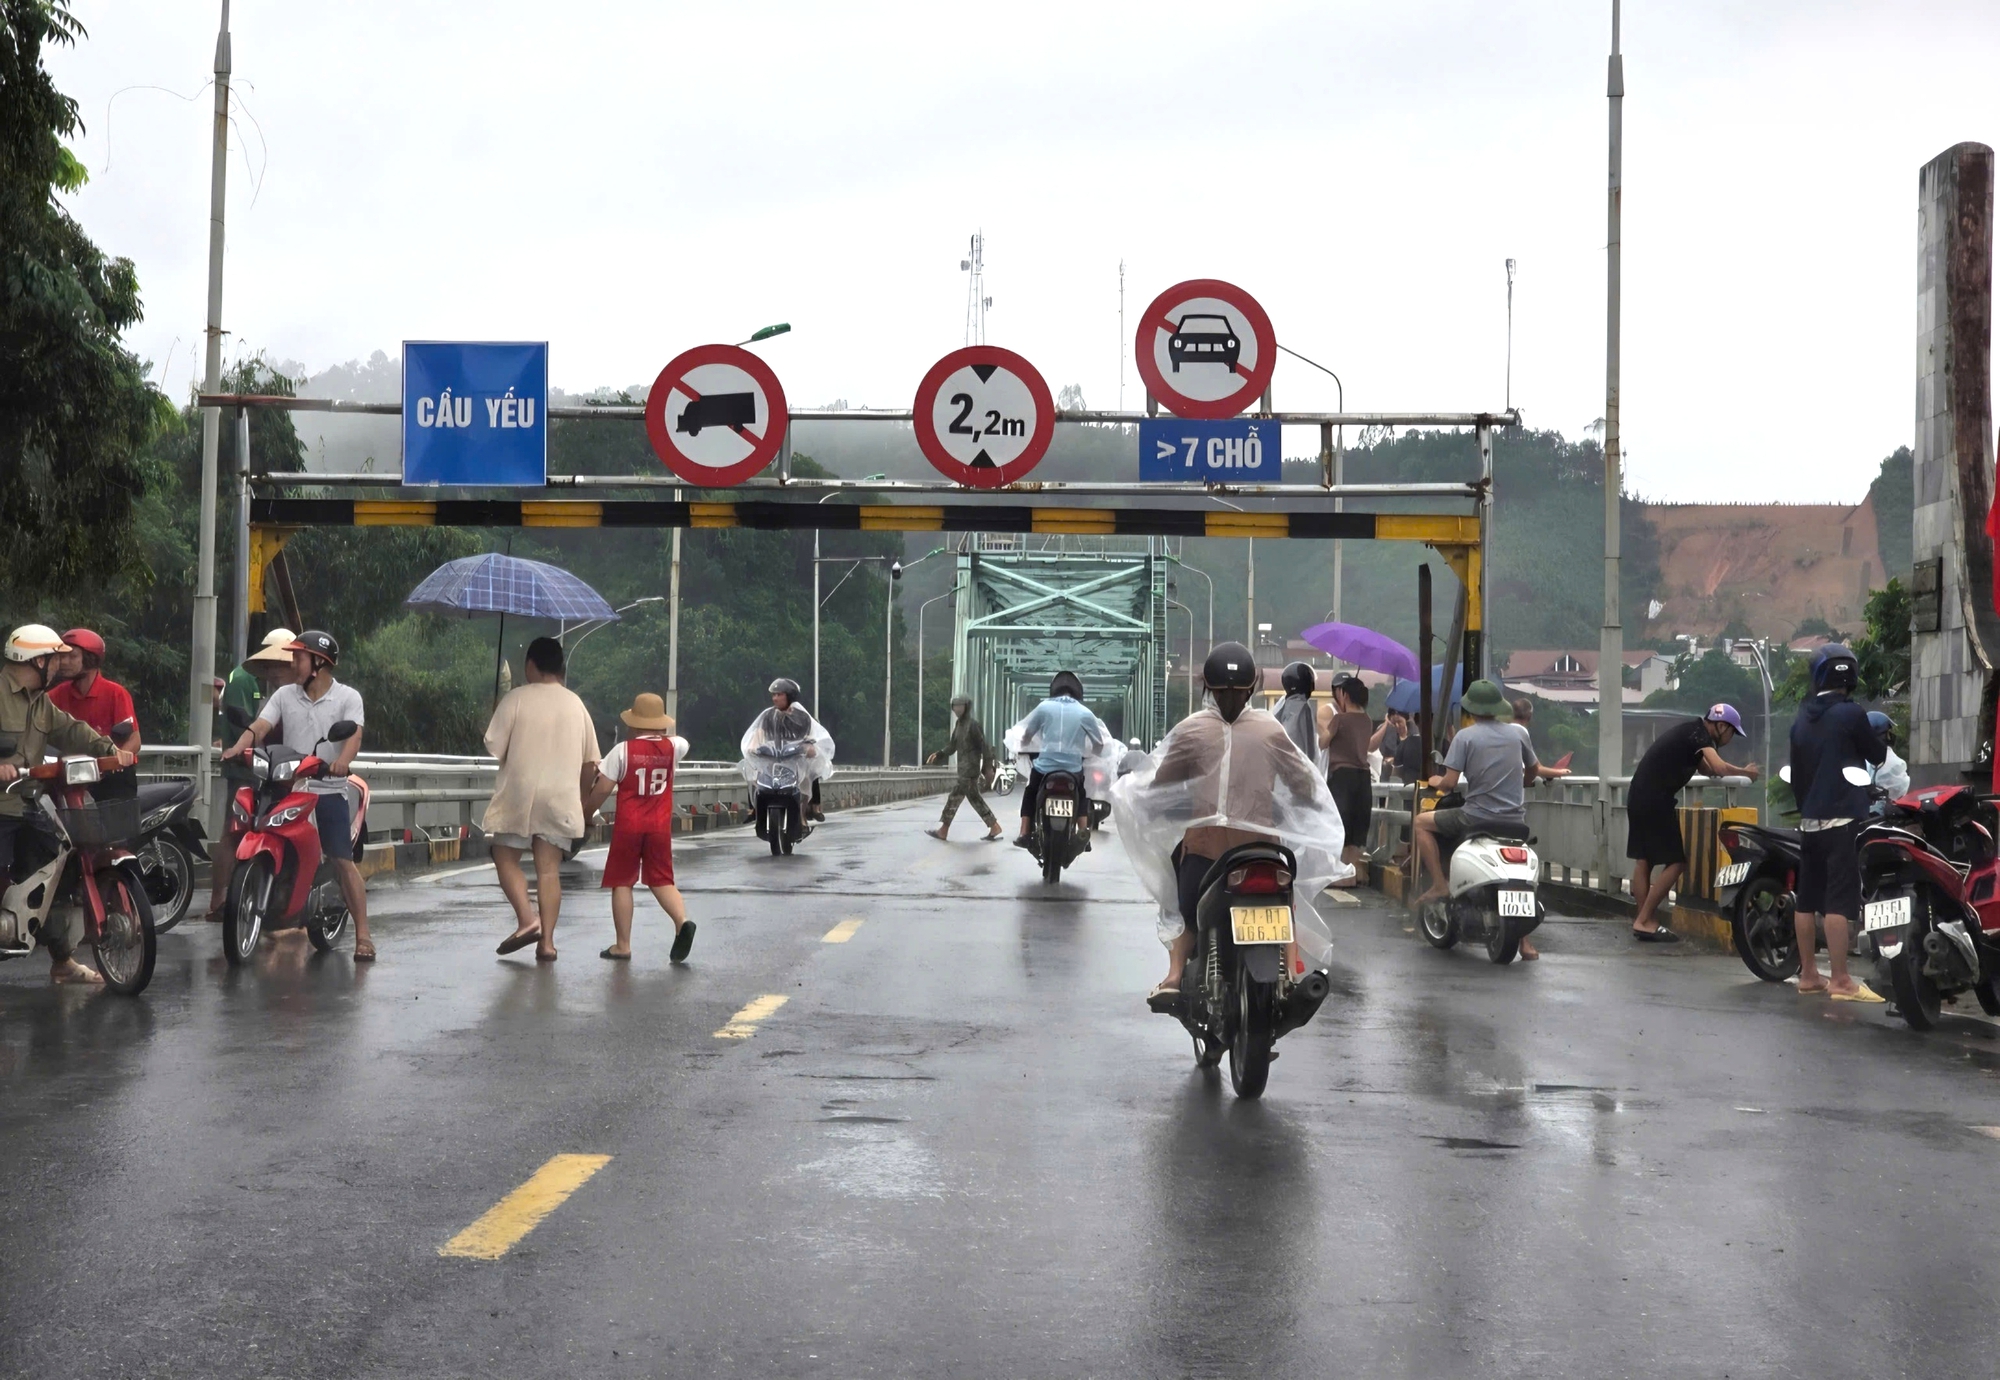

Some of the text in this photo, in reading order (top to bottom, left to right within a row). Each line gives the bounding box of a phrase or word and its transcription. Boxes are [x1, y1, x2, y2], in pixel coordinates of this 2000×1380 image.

[417, 386, 535, 428] CẦU YẾU
[949, 393, 1025, 443] 2,2m
[1181, 437, 1199, 467] 7
[1207, 425, 1262, 468] CHỖ
[635, 768, 668, 796] 18
